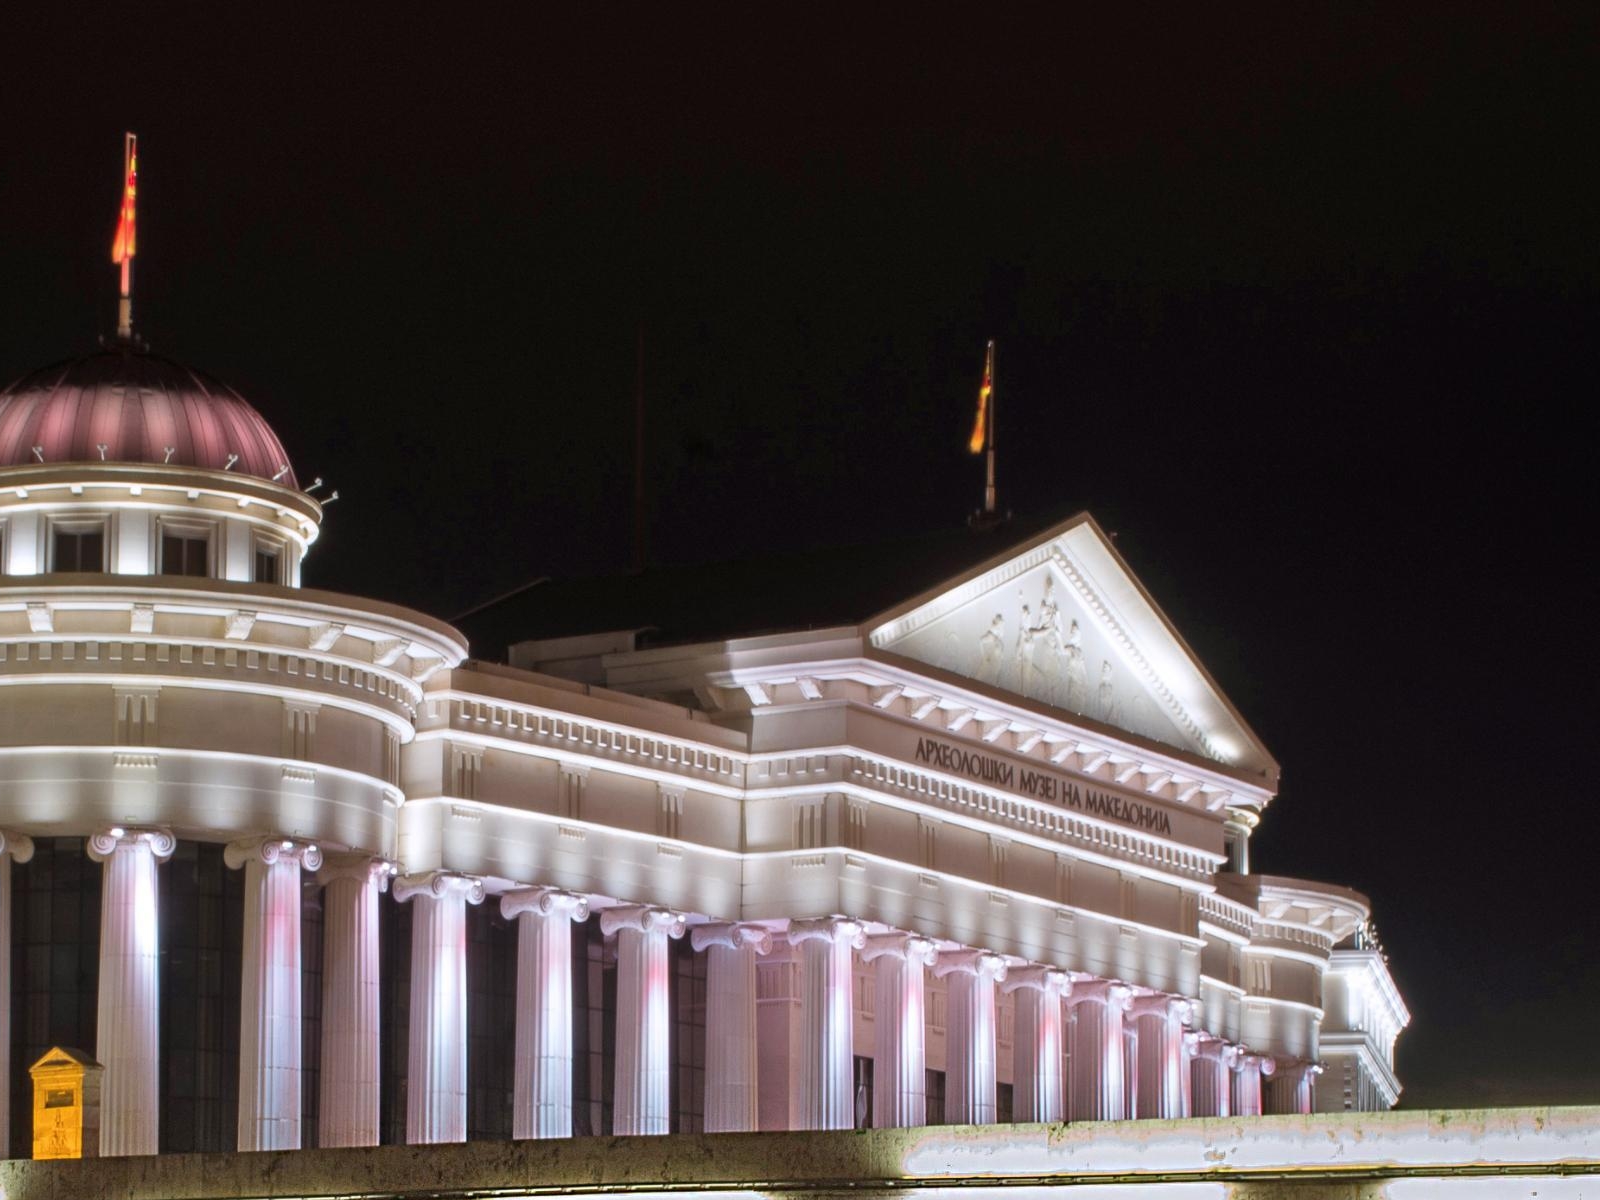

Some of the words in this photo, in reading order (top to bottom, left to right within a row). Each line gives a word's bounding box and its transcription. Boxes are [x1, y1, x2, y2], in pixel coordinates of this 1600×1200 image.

[915, 737, 1014, 788] АРХЕОЛОШКИ
[1020, 768, 1057, 801] МУЗЕЈ
[1062, 781, 1081, 808] НА
[1085, 789, 1171, 834] МАКЕДОНИЈА
